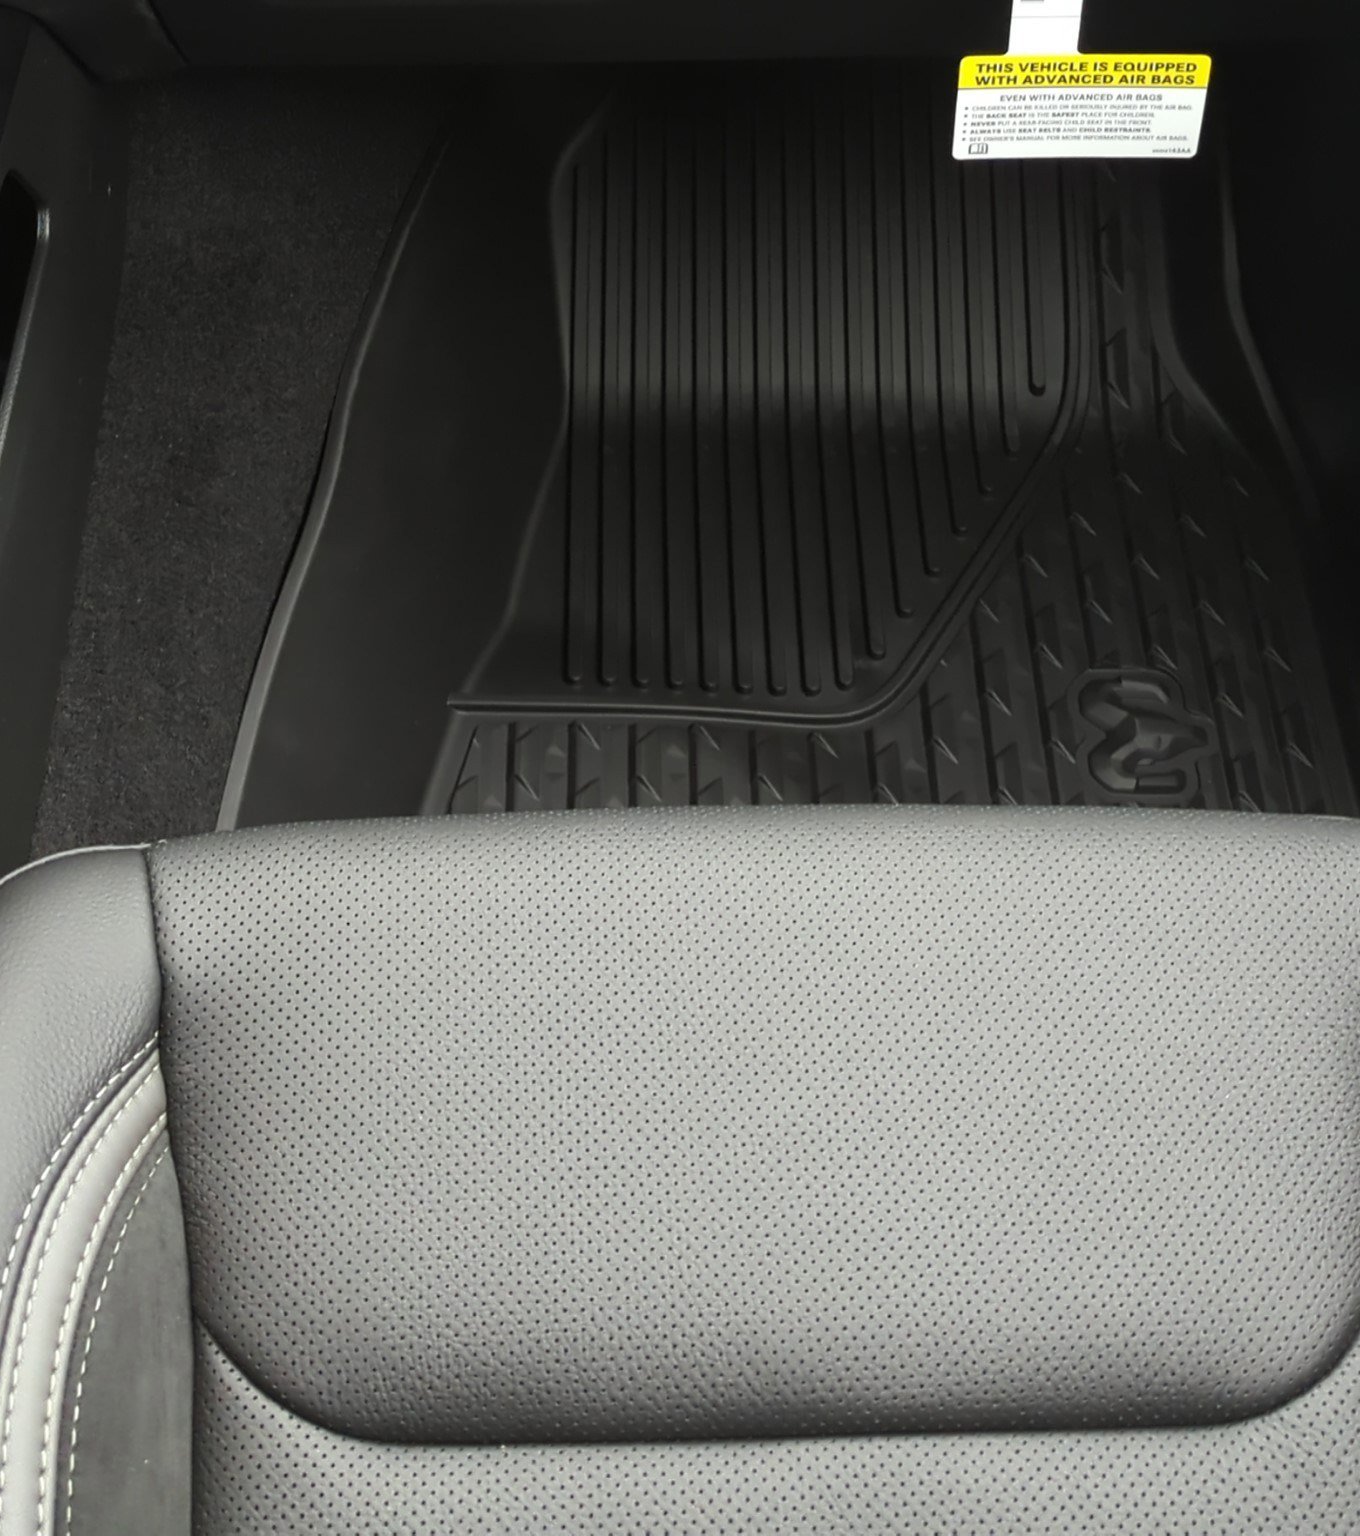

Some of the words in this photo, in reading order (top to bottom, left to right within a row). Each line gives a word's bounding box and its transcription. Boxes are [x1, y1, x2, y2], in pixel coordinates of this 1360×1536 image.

[976, 63, 1014, 73] THIS
[1019, 62, 1089, 73] VEHICLE
[1093, 62, 1108, 72] IS
[1114, 62, 1198, 73] EQUIPPED
[975, 75, 1018, 85] WITH
[1022, 74, 1114, 85] ADVANCED
[1118, 74, 1146, 85] AIR
[1151, 75, 1195, 85] BAGS
[1000, 94, 1027, 102] EVEN
[1029, 94, 1055, 102] WITH
[1058, 93, 1114, 102] ADVANCED
